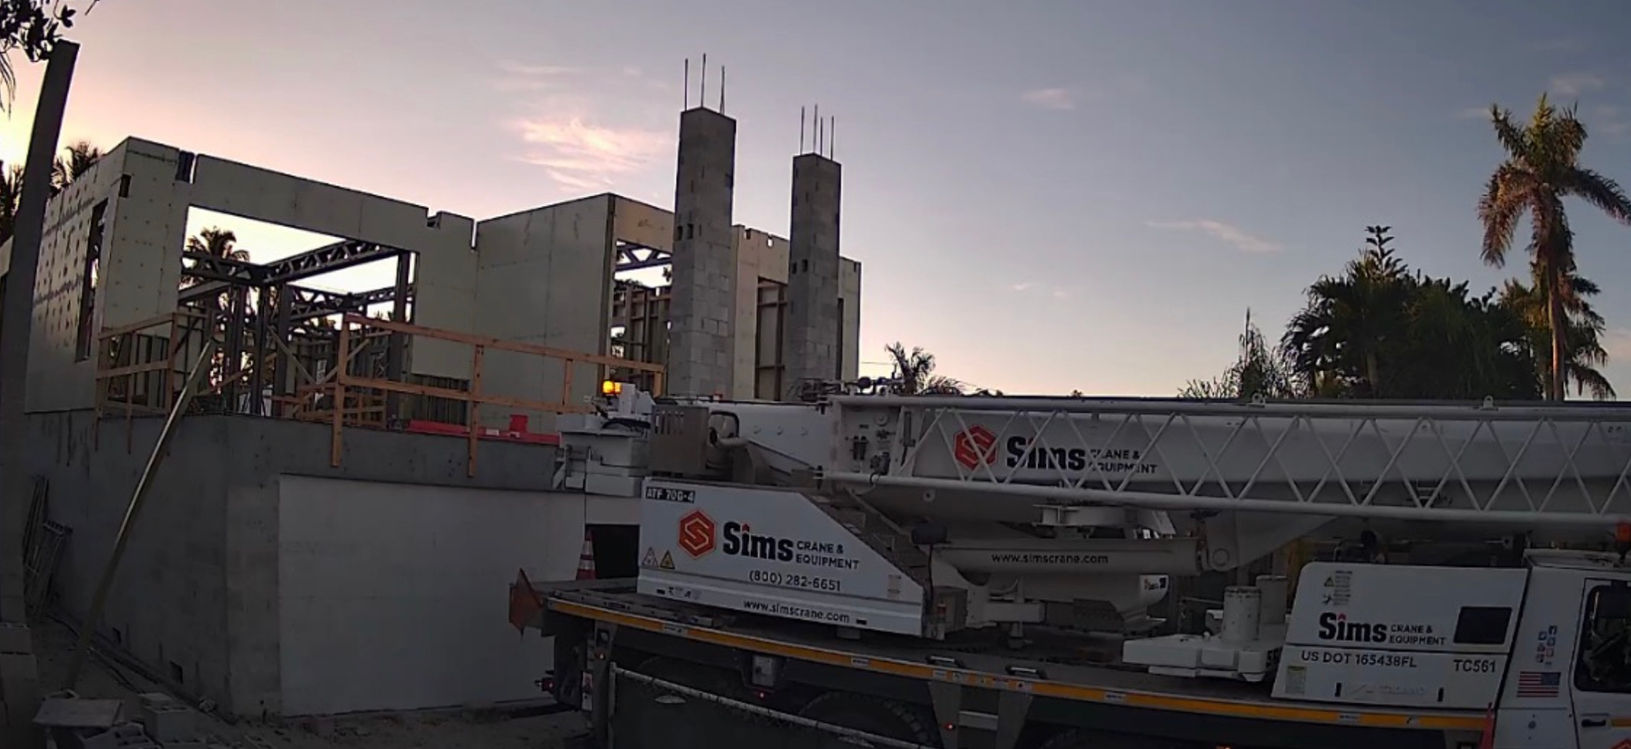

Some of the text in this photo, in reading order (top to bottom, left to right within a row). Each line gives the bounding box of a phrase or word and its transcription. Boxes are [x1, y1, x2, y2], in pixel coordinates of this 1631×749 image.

[1007, 436, 1086, 471] Sims
[723, 521, 794, 562] Sims
[796, 541, 834, 554] CRANE
[837, 544, 844, 554] &
[796, 554, 860, 569] EQUIPMENT
[991, 552, 1109, 565] www.simscrane.com
[750, 570, 841, 592] (800) 282-6651
[743, 600, 850, 624] www.simscrane.com
[1318, 612, 1433, 643] Sims CRANE &
[1388, 635, 1446, 646] EQUIPMENT
[1301, 651, 1417, 668] US DOT 165438FL
[1453, 659, 1497, 673] TC561
